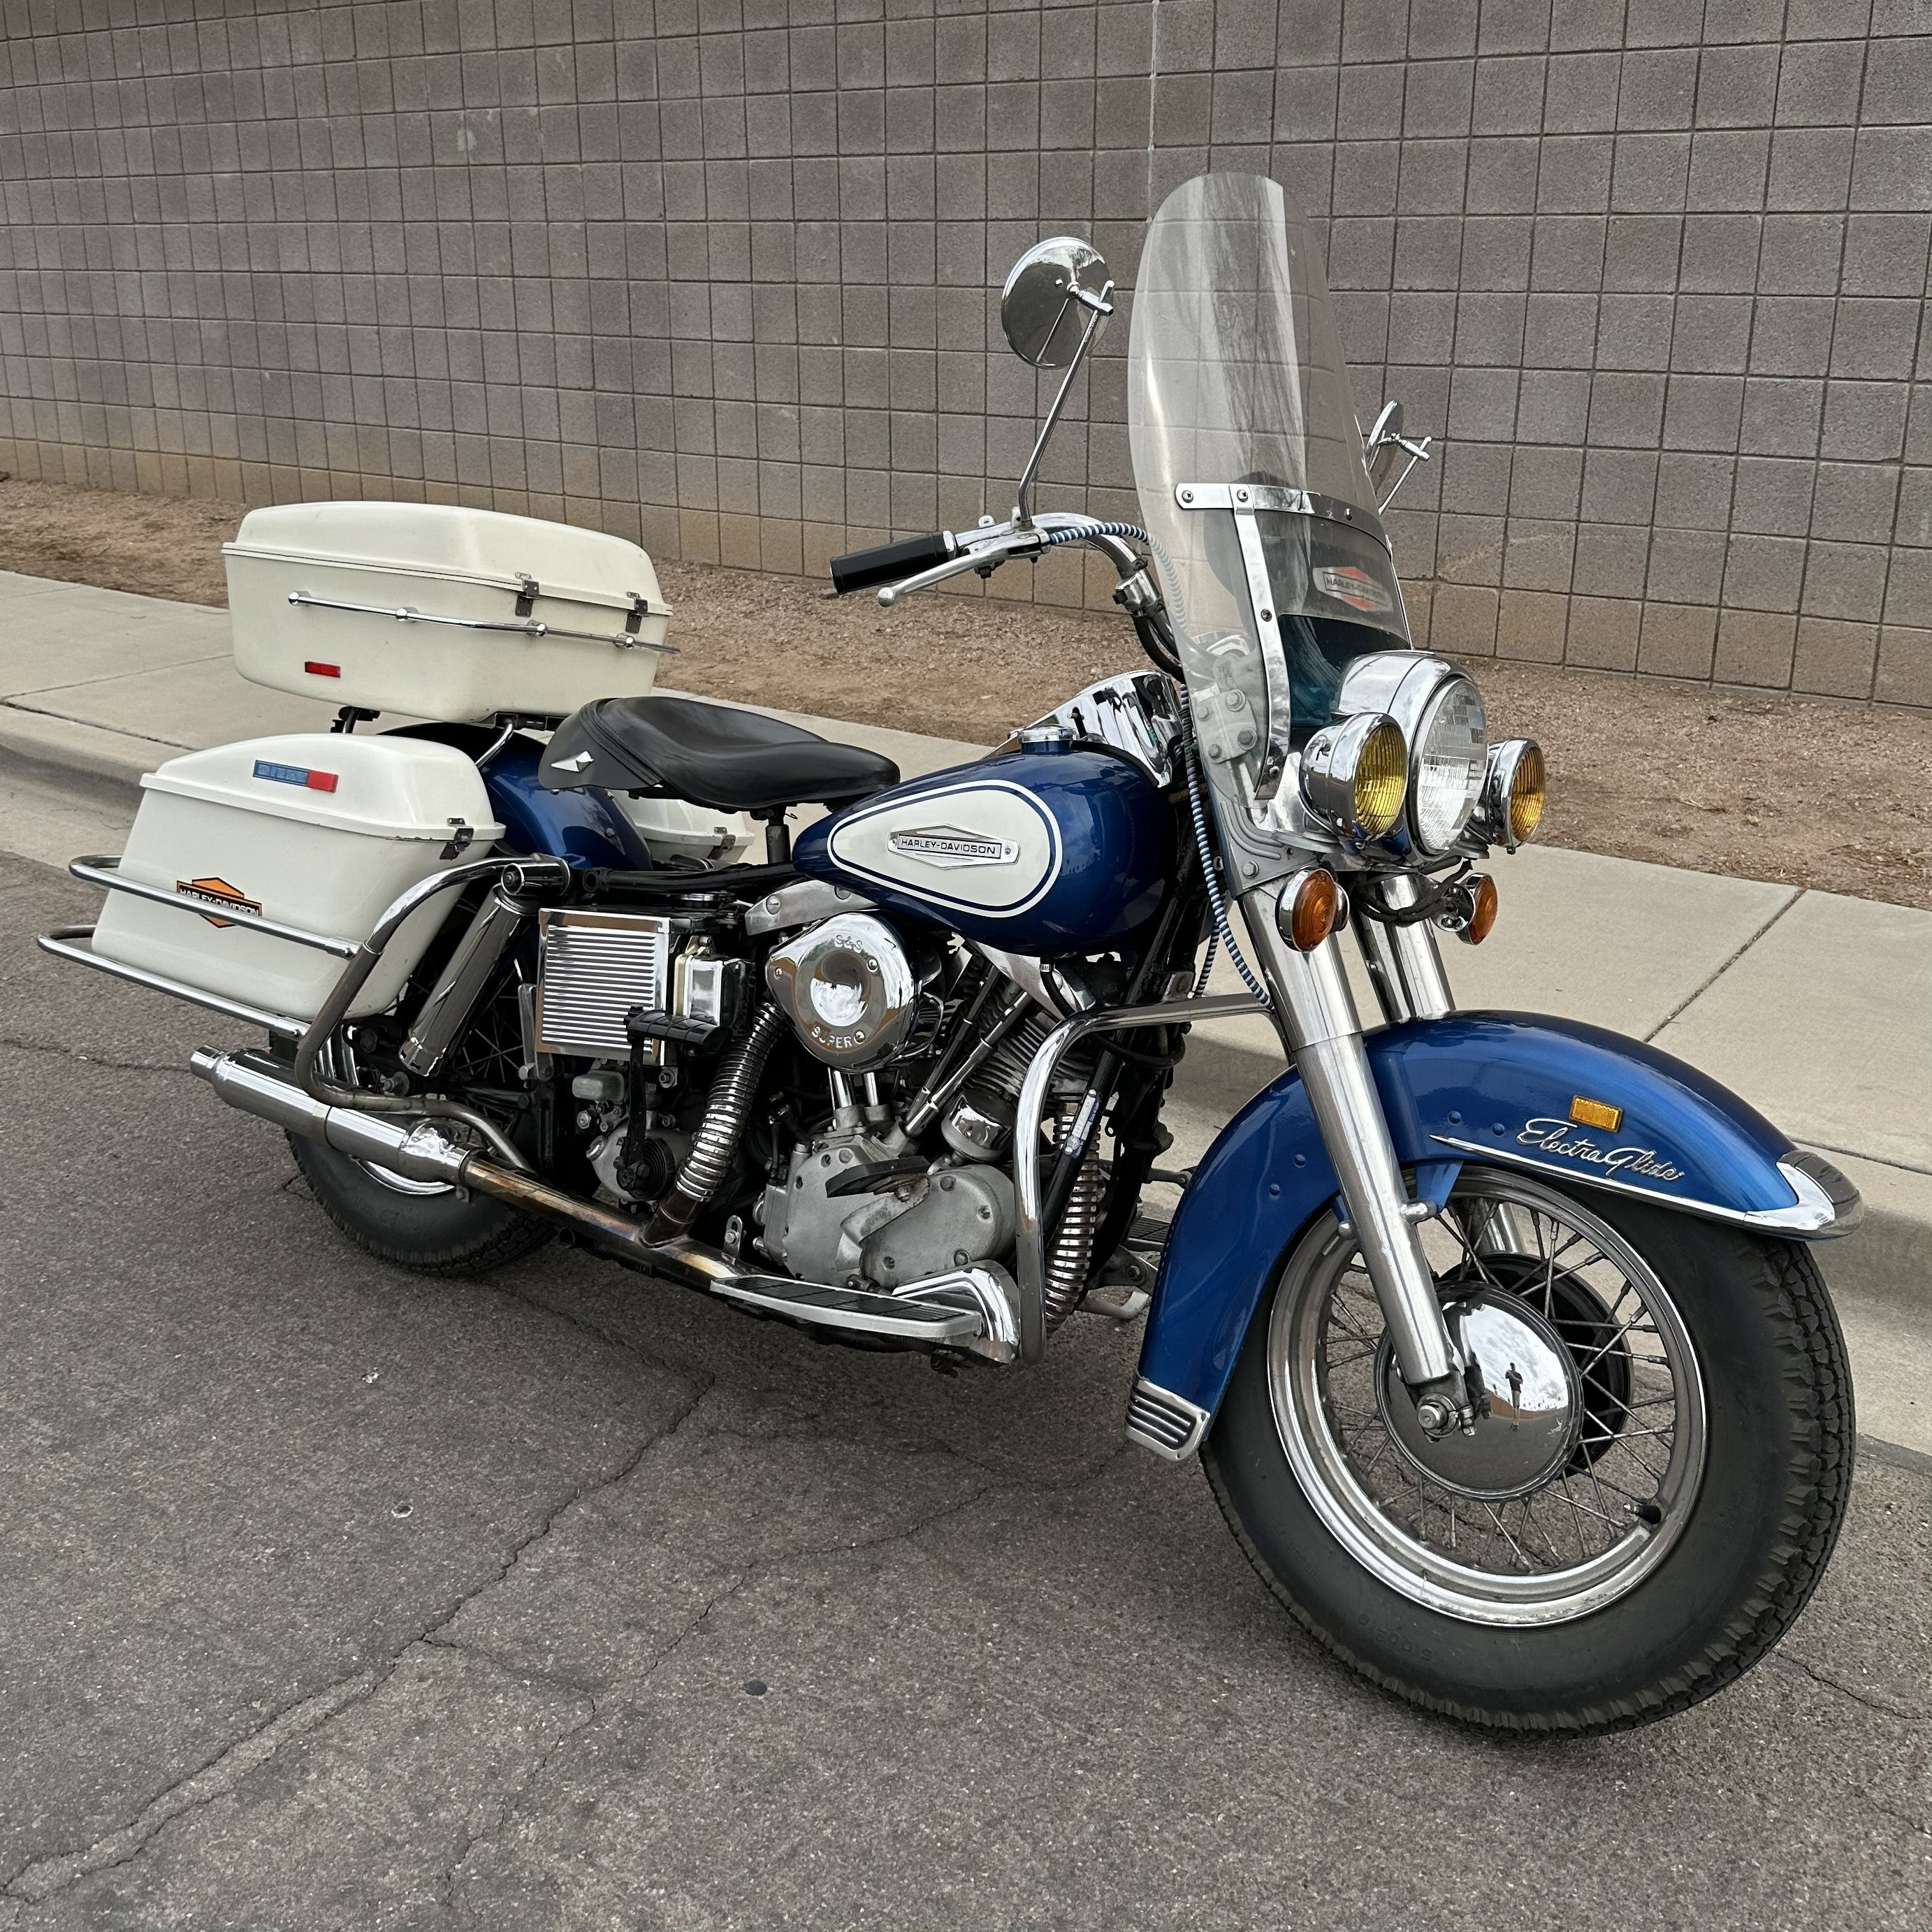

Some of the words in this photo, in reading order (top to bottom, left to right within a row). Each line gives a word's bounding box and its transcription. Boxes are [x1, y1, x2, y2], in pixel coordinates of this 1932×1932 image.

[901, 838, 996, 855] HARLEY-DAVIDSON
[835, 934, 864, 952] S&S
[811, 1025, 852, 1048] SUPER
[1516, 1118, 1606, 1163] Electra
[1604, 1147, 1685, 1182] Glide
